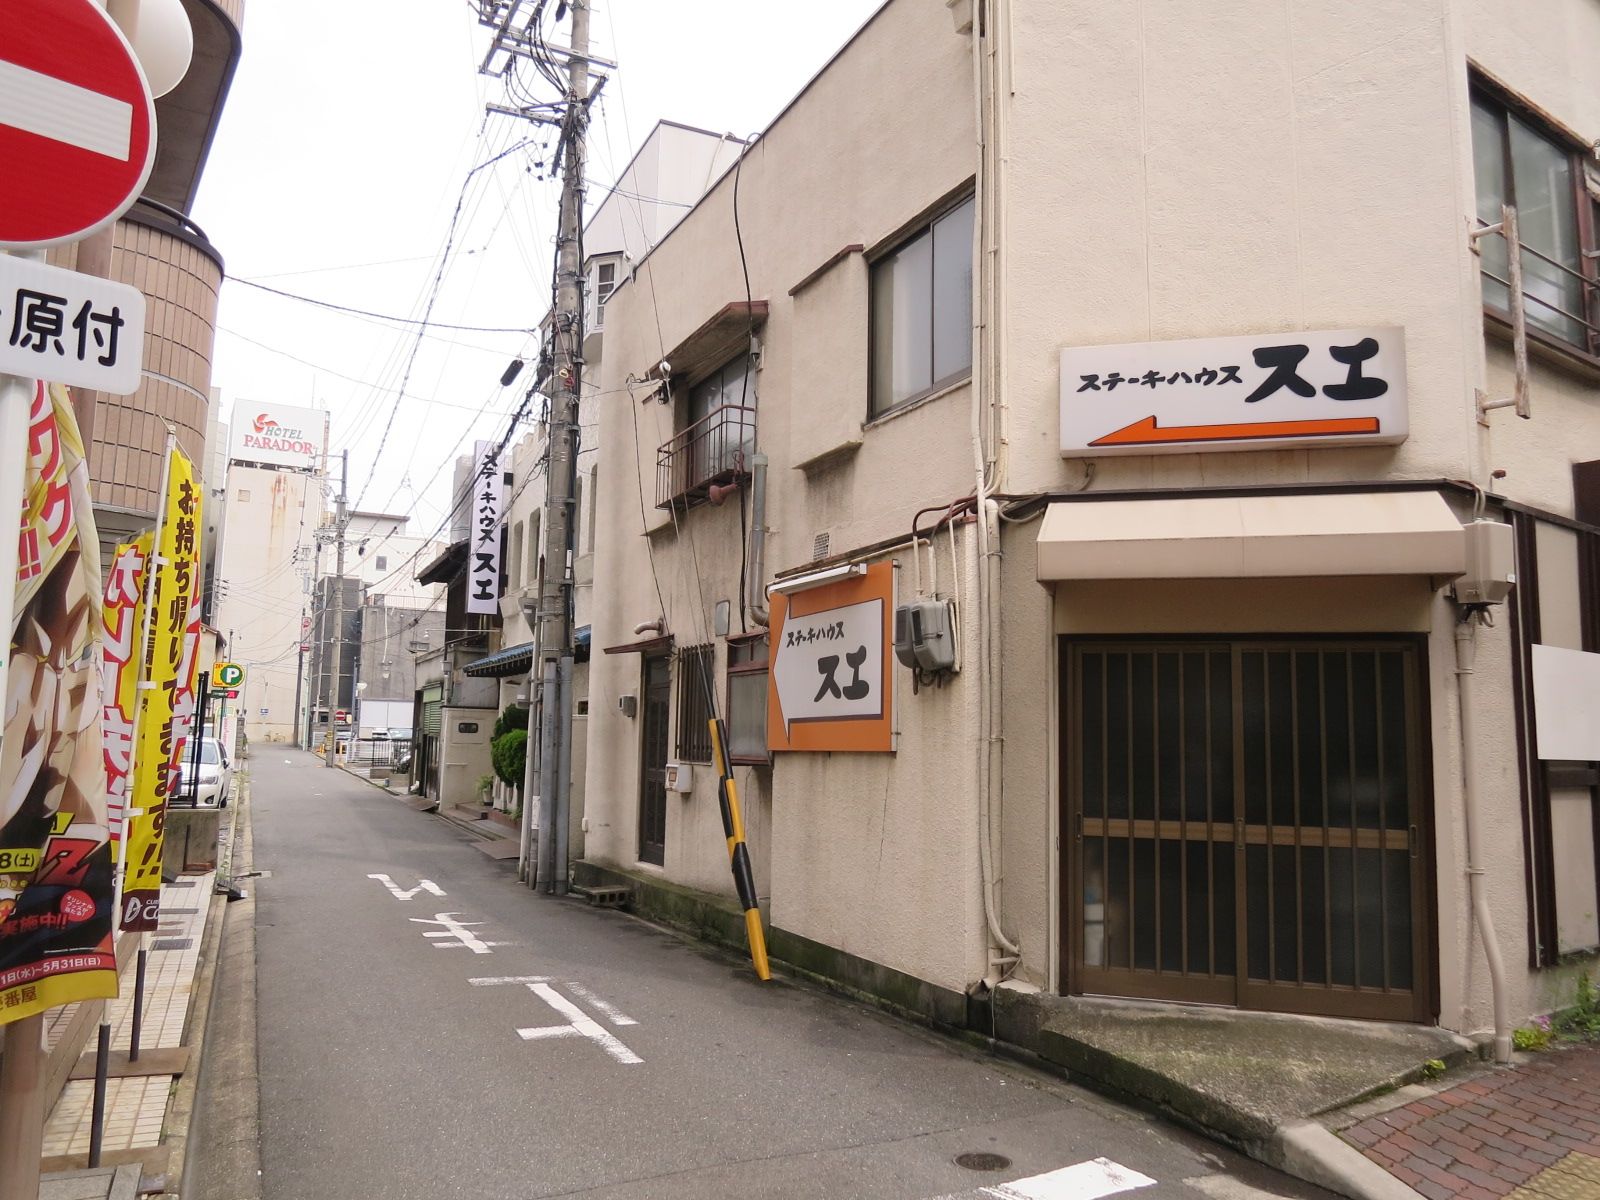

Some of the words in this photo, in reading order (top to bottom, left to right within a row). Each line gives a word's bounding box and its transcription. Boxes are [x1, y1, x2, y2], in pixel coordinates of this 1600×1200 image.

[9, 288, 125, 366] 原付
[1076, 365, 1243, 393] ステーキハウス
[1244, 337, 1389, 403] スエ
[243, 434, 314, 455] PARADOR
[265, 426, 303, 440] HOTEL
[477, 454, 498, 543] ステーキハウス
[472, 552, 497, 600] スエ
[786, 621, 845, 648] ステーキハウス
[226, 667, 240, 683] P
[814, 645, 870, 703] スエ
